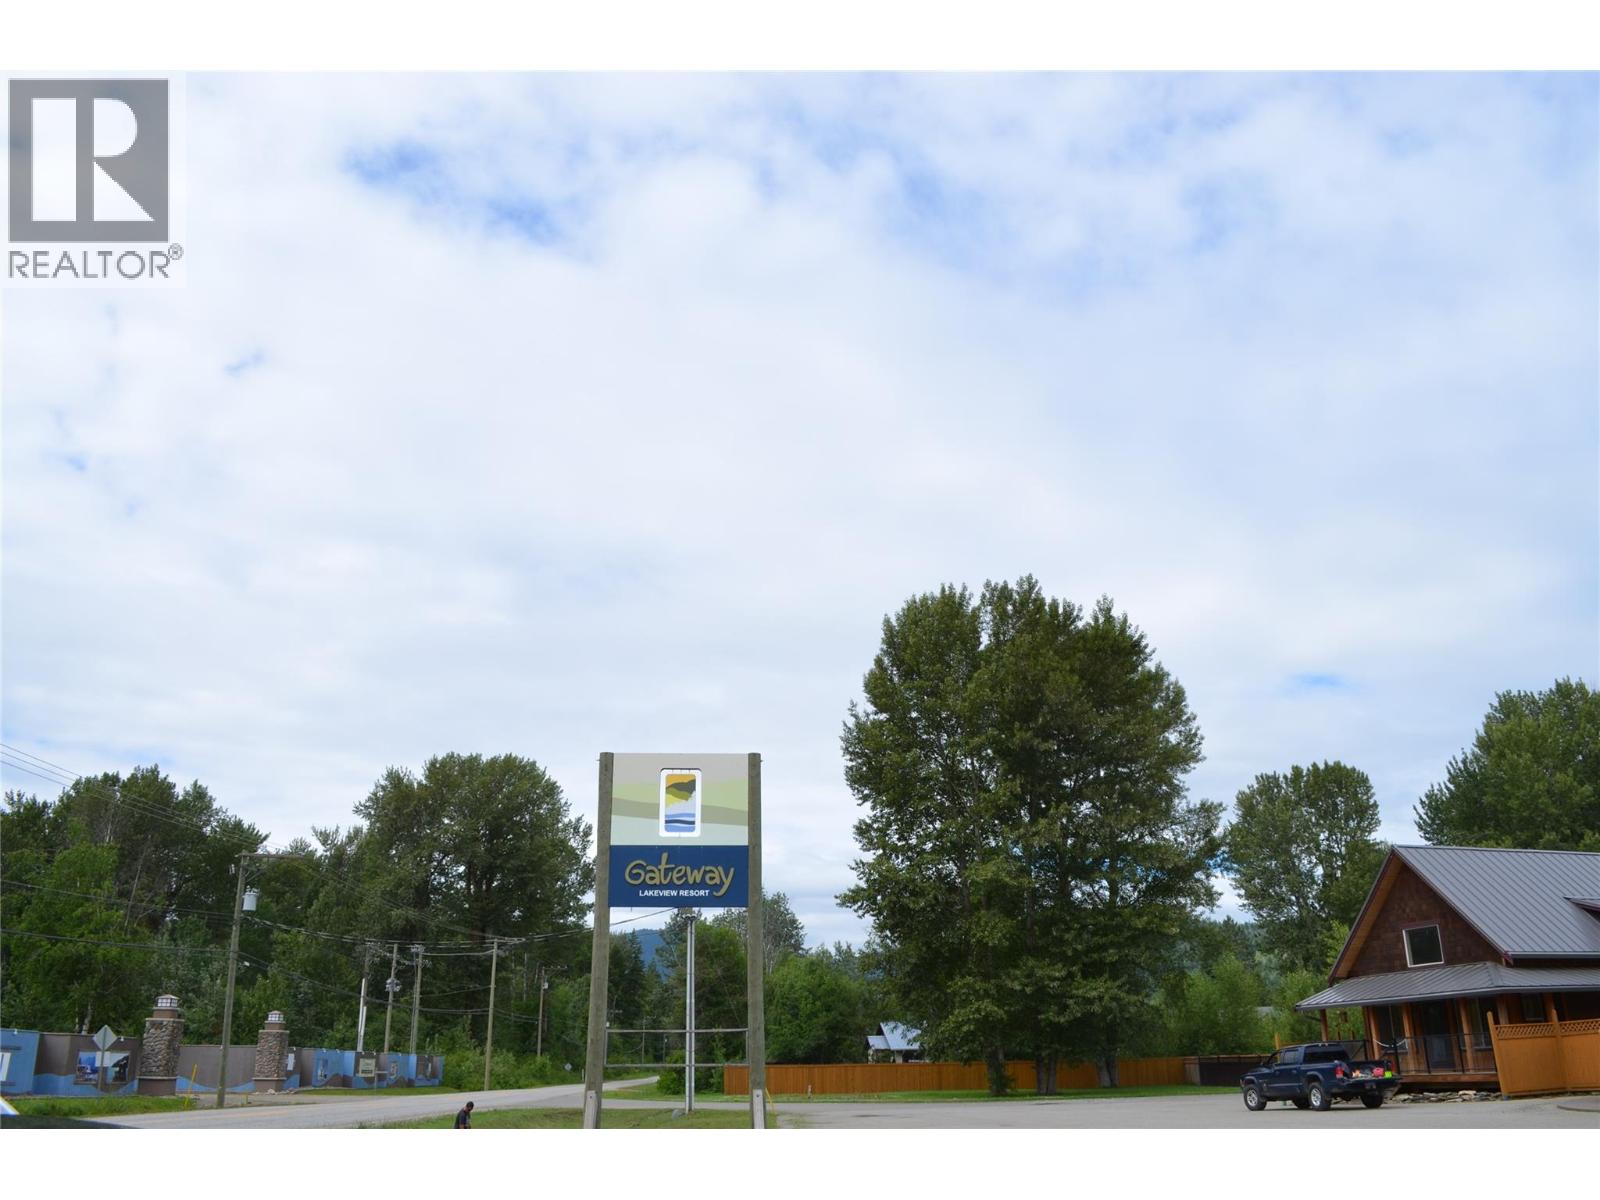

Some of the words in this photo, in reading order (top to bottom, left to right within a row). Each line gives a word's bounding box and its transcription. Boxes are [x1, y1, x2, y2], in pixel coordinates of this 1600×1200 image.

[624, 851, 735, 897] Gateway
[639, 889, 678, 897] LAKEVIEW
[679, 889, 710, 897] RESORT
